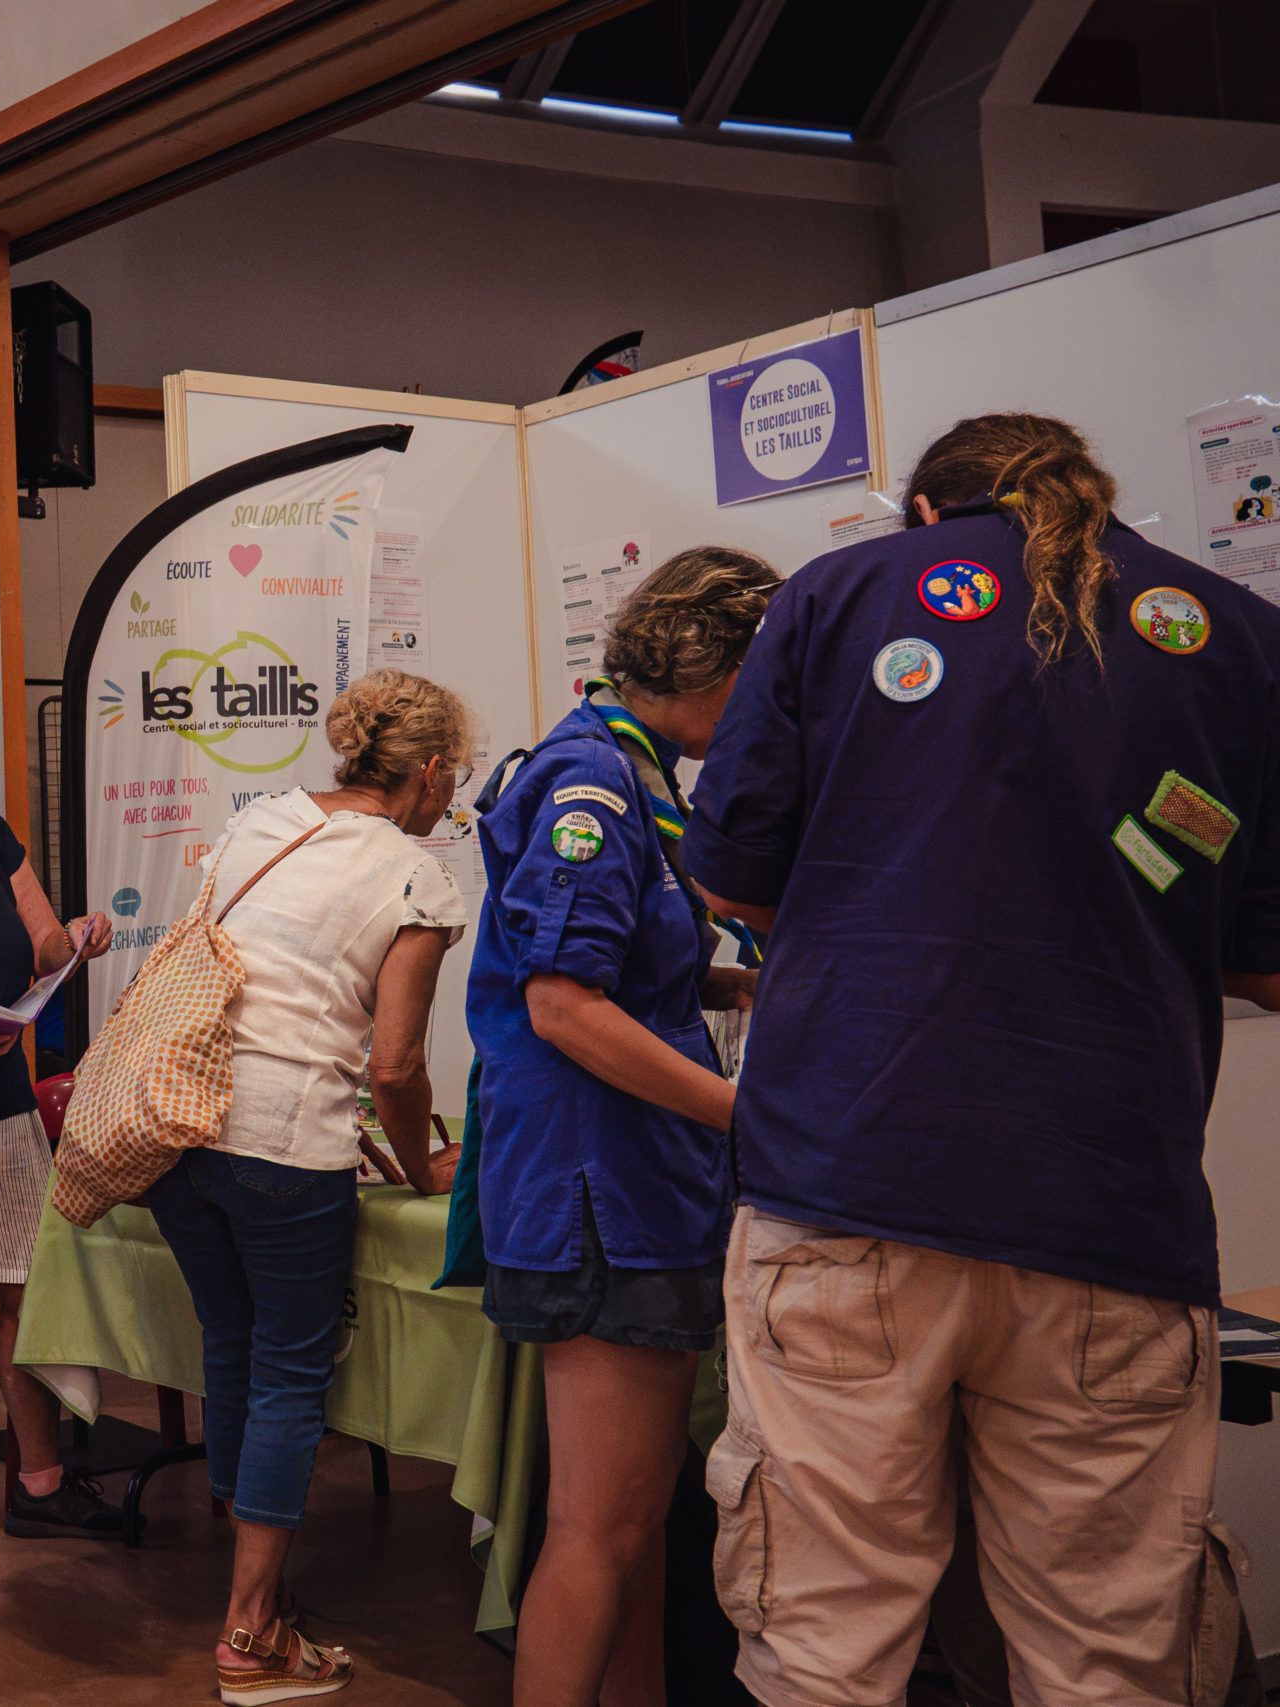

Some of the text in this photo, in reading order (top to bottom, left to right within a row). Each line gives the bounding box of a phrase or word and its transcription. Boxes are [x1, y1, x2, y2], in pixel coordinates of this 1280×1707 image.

[750, 379, 821, 410] CENTRE SOCIAL
[744, 401, 831, 436] ET SOCIOCULTUREL
[755, 426, 821, 457] LES TAILLIS
[231, 499, 326, 528] SOLIDARITÉ
[167, 560, 212, 580] ÉCOUTE
[261, 576, 344, 597] CONVIVIALITÉ
[127, 618, 177, 639] PARTAGE
[142, 665, 319, 721] les taillis
[143, 724, 175, 734] Centre
[178, 721, 206, 731] social
[209, 721, 219, 730] et
[222, 719, 288, 729] socioculturel
[298, 719, 318, 728] Bron
[104, 777, 210, 801] UN LIEU POUR TOUS,
[123, 805, 192, 825] AVEC CHACUN
